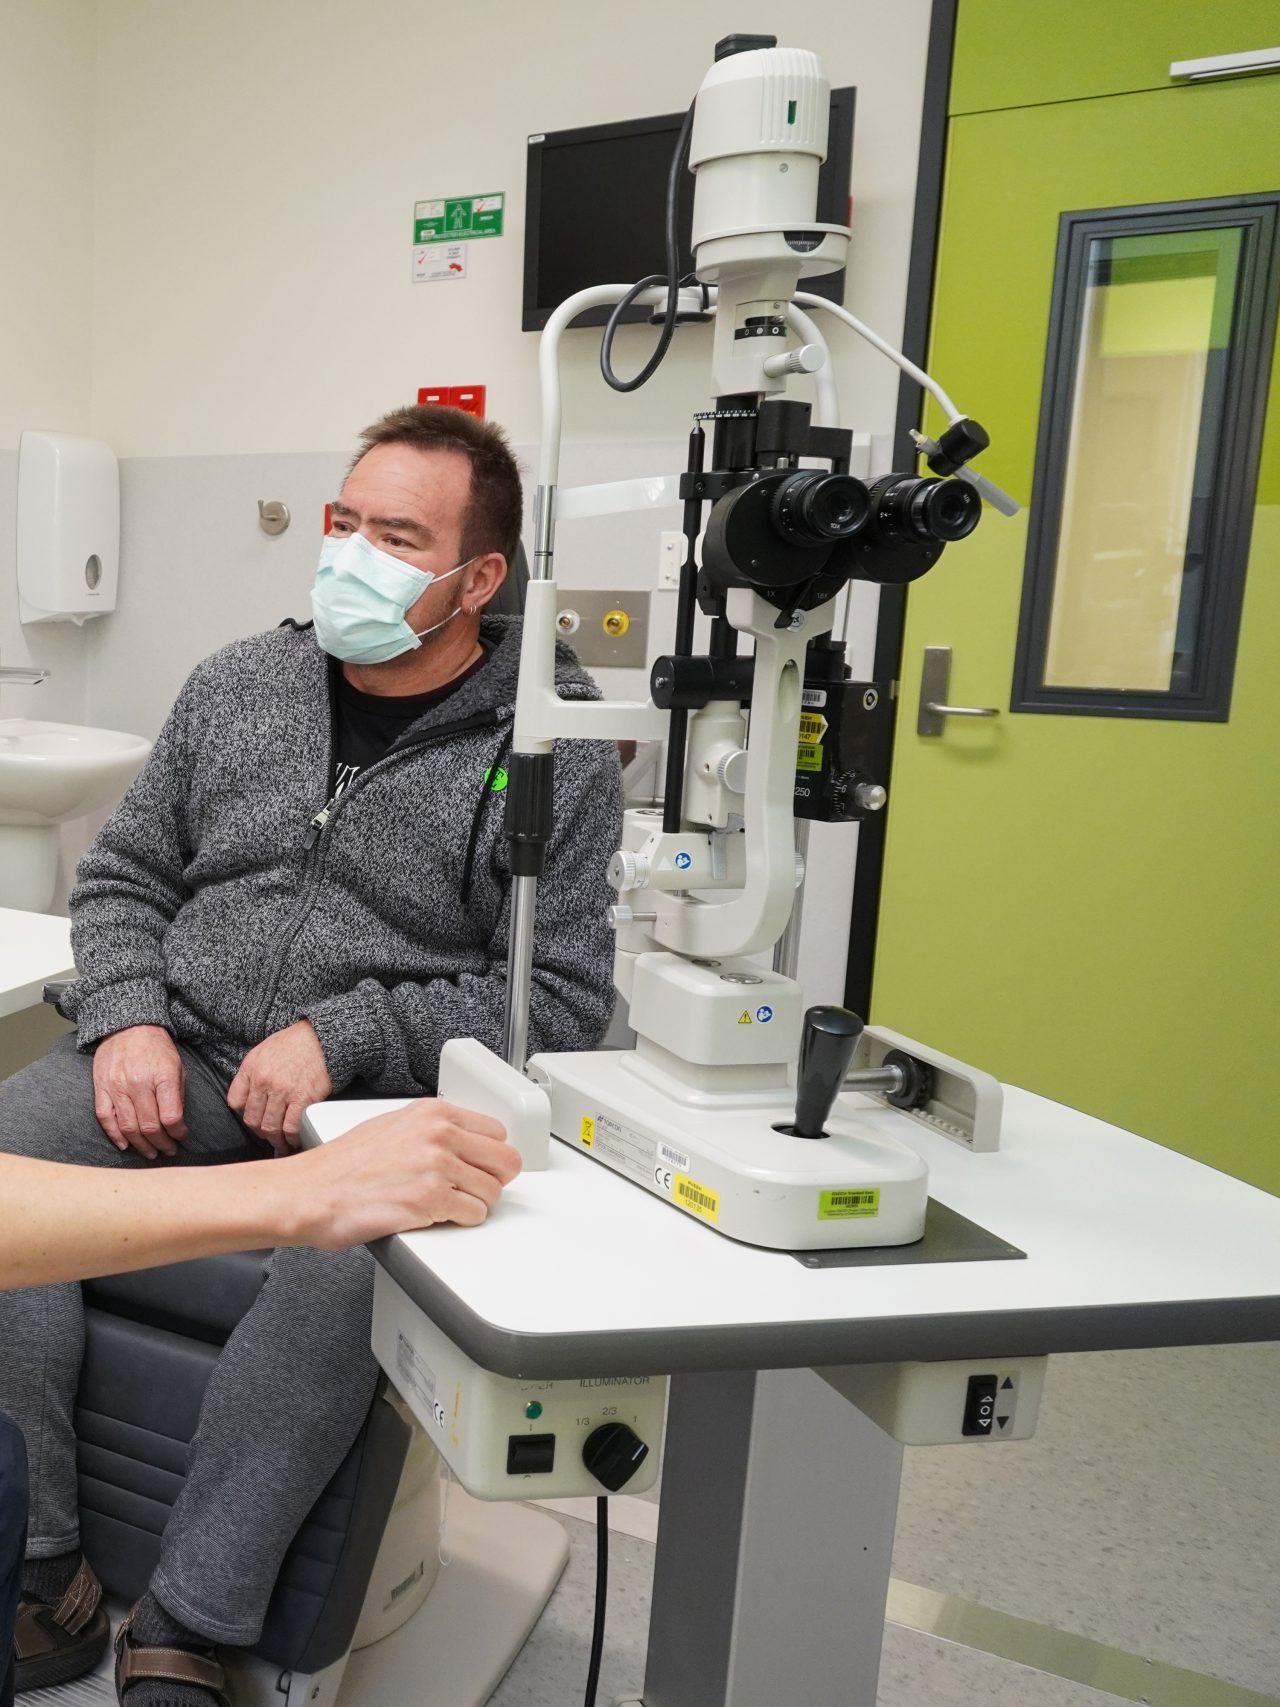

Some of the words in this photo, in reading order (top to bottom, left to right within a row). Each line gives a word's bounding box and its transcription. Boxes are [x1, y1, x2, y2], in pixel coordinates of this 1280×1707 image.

[579, 1376, 651, 1388] ILLUMINATOR
[601, 1407, 618, 1416] 2/3
[576, 1417, 591, 1426] 1/3
